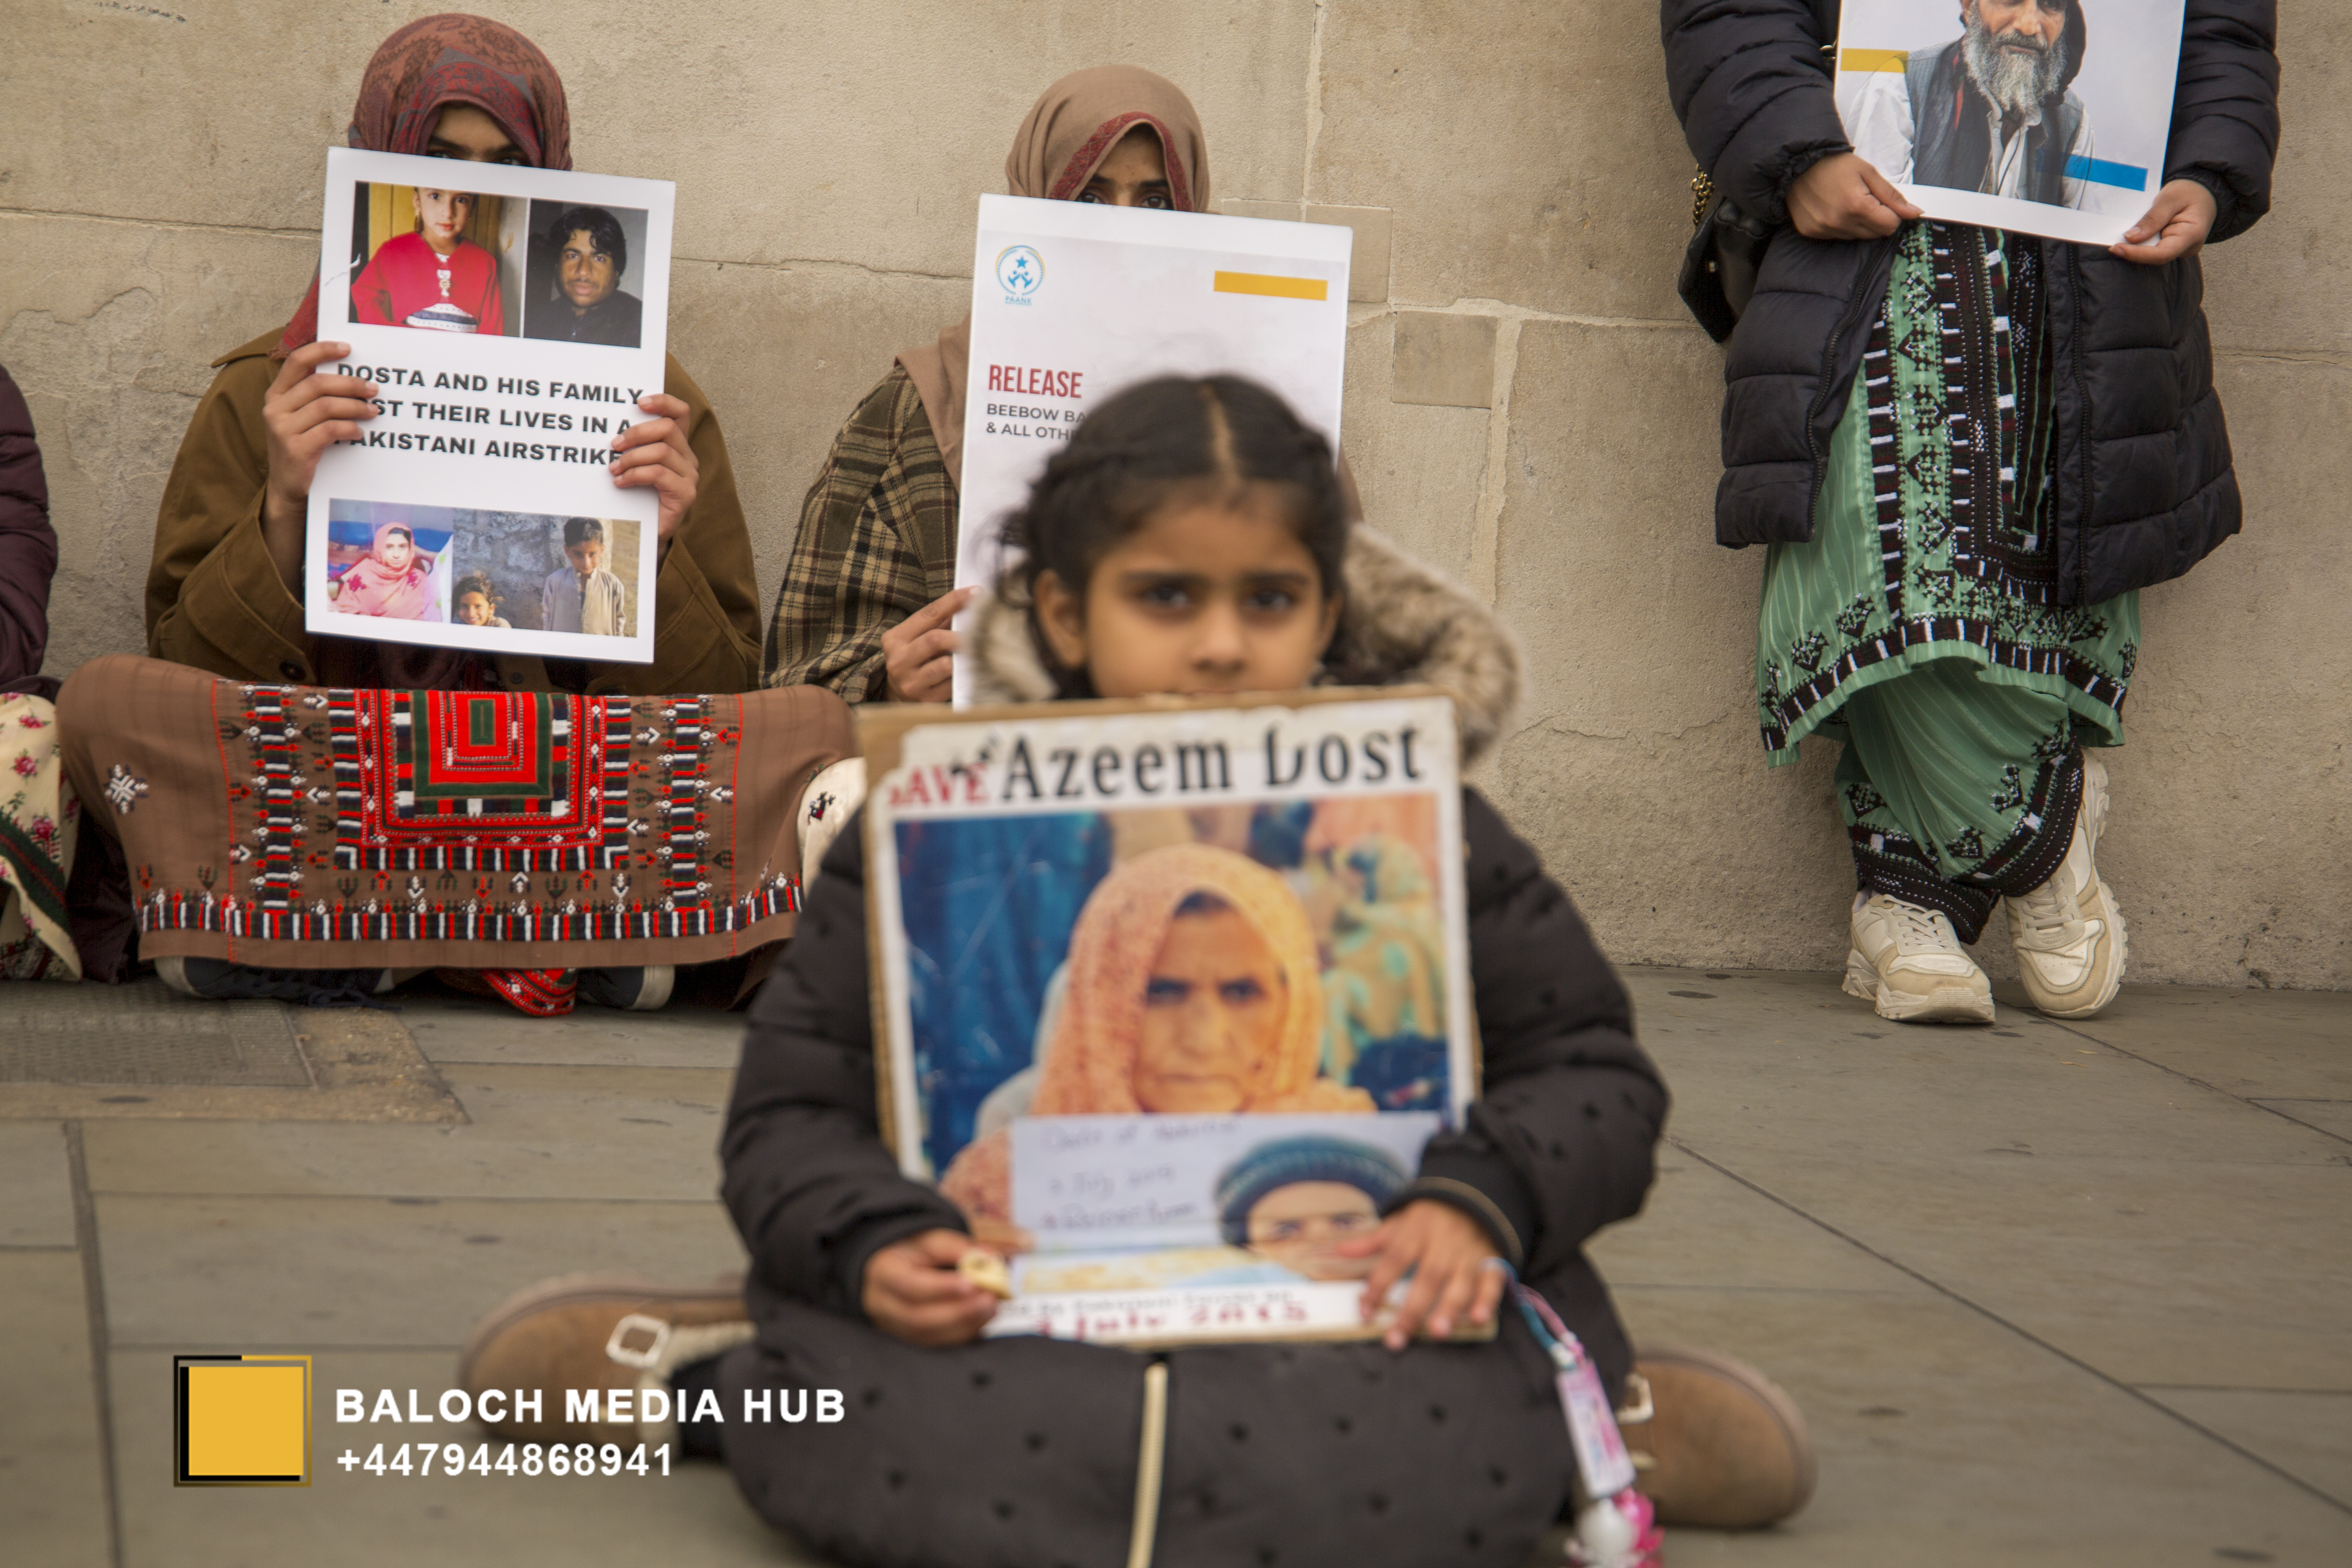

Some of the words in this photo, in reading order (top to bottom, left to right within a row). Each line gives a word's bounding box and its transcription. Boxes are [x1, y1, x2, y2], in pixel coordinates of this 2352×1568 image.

[1005, 295, 1032, 303] PAANK
[338, 363, 425, 386] DOSTA
[434, 372, 488, 391] AND
[498, 377, 540, 396] HIS
[550, 381, 644, 405] FAMILY
[989, 364, 1083, 398] RELEASE
[354, 397, 403, 416] ST
[412, 401, 490, 424] THEIR
[500, 409, 573, 431] LIVES
[582, 416, 608, 434] IN
[617, 419, 630, 434] A
[987, 403, 1060, 421] BEEBOW
[987, 422, 996, 433] &
[1001, 423, 1031, 437] ALL
[1002, 735, 1234, 800] Azeem
